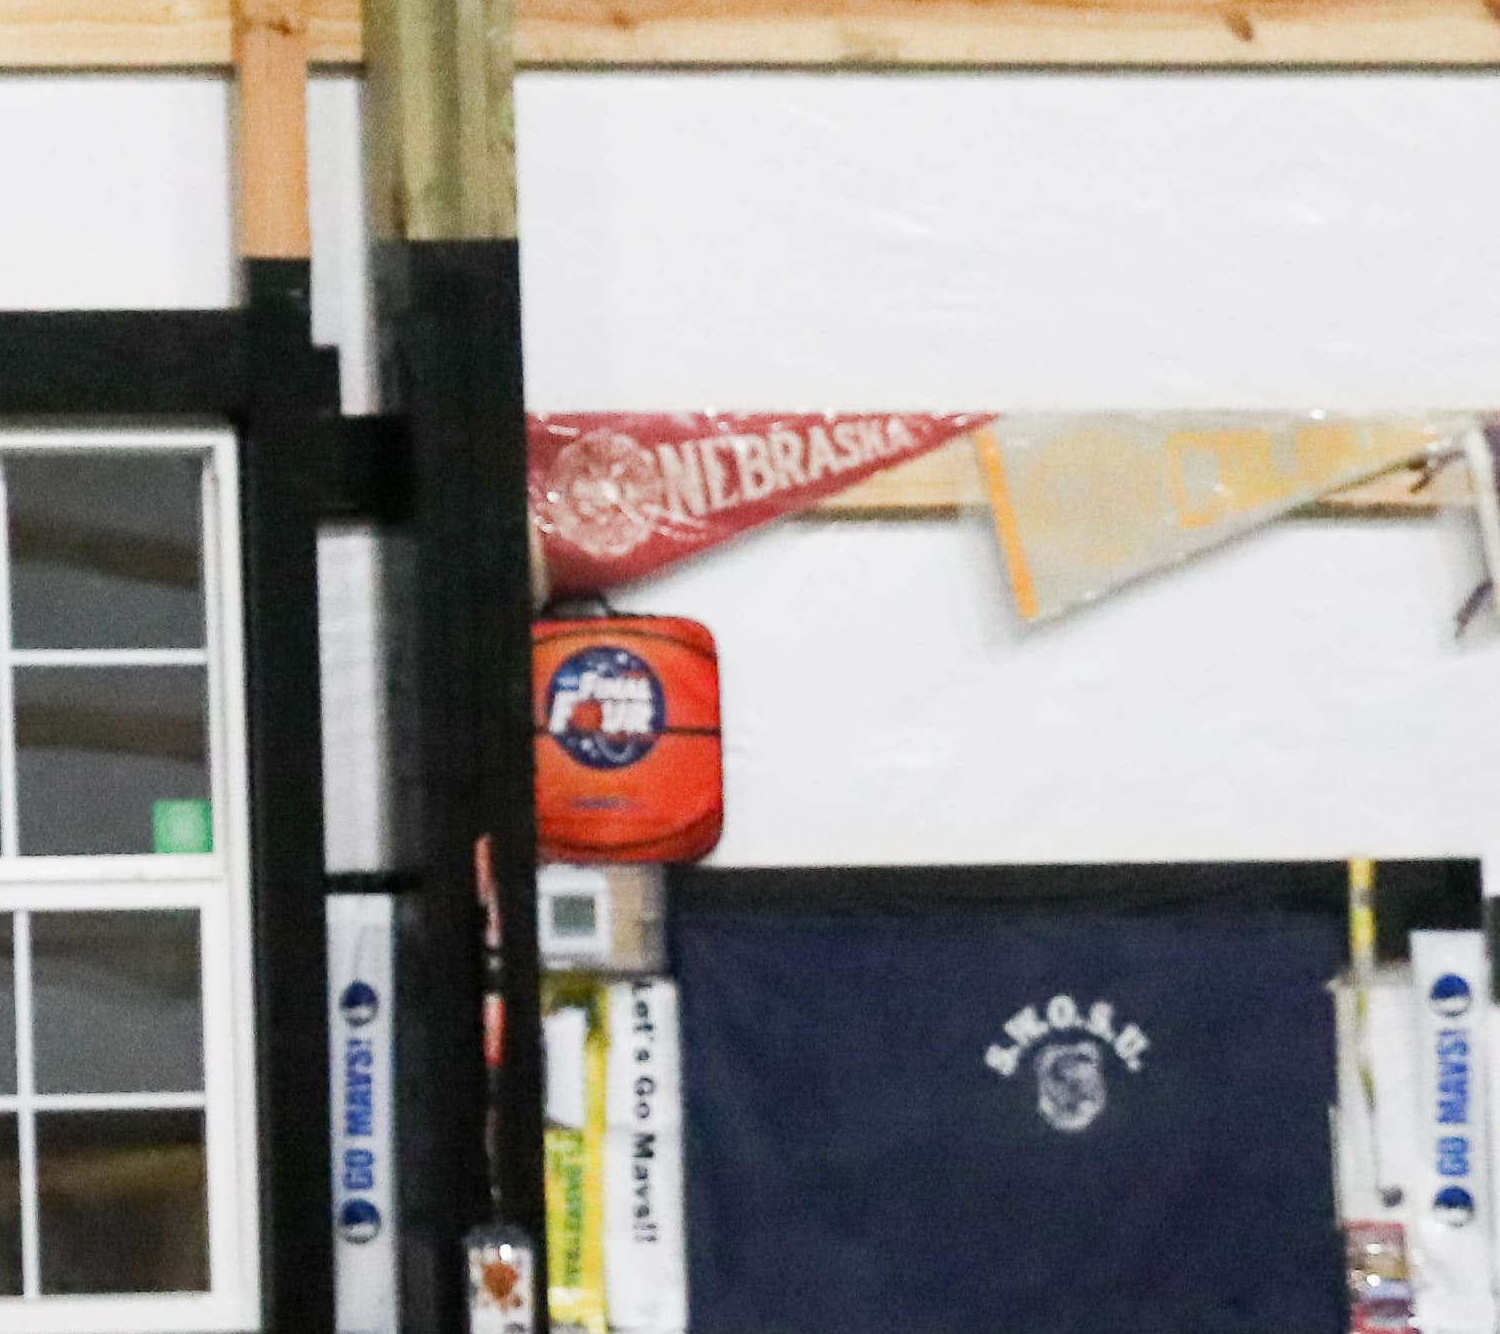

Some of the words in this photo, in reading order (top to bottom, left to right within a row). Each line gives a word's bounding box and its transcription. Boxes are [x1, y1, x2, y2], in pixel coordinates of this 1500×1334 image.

[656, 417, 914, 517] NEBRASKA
[343, 1038, 375, 1138] MAVS!
[634, 1076, 656, 1120] Go
[343, 1147, 375, 1191] GO
